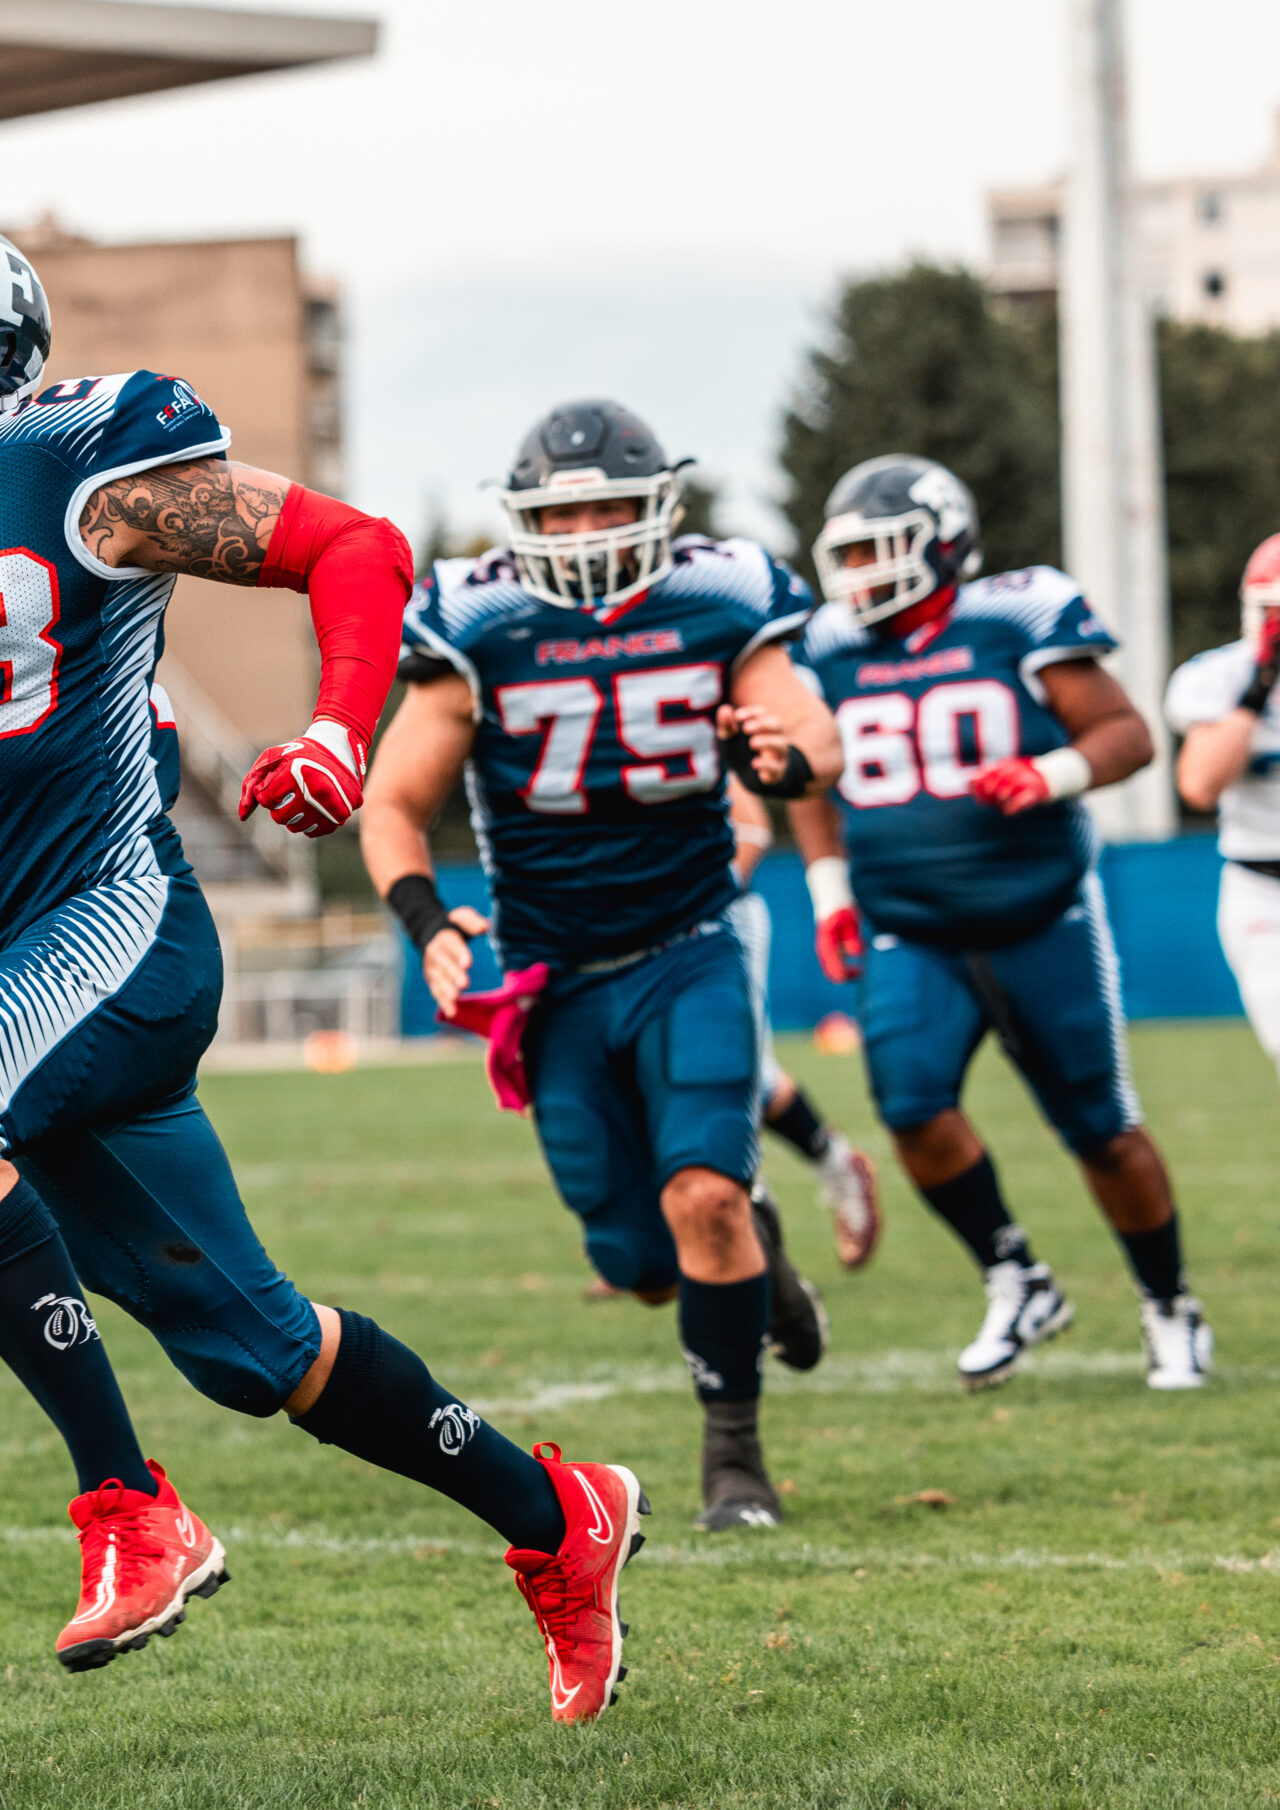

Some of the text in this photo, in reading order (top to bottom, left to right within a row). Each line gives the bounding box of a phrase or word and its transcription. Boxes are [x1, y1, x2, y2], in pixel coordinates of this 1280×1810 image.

[156, 397, 194, 425] FFFA
[535, 629, 684, 666] FRANCE
[494, 661, 723, 814] 75
[835, 679, 1020, 809] 60
